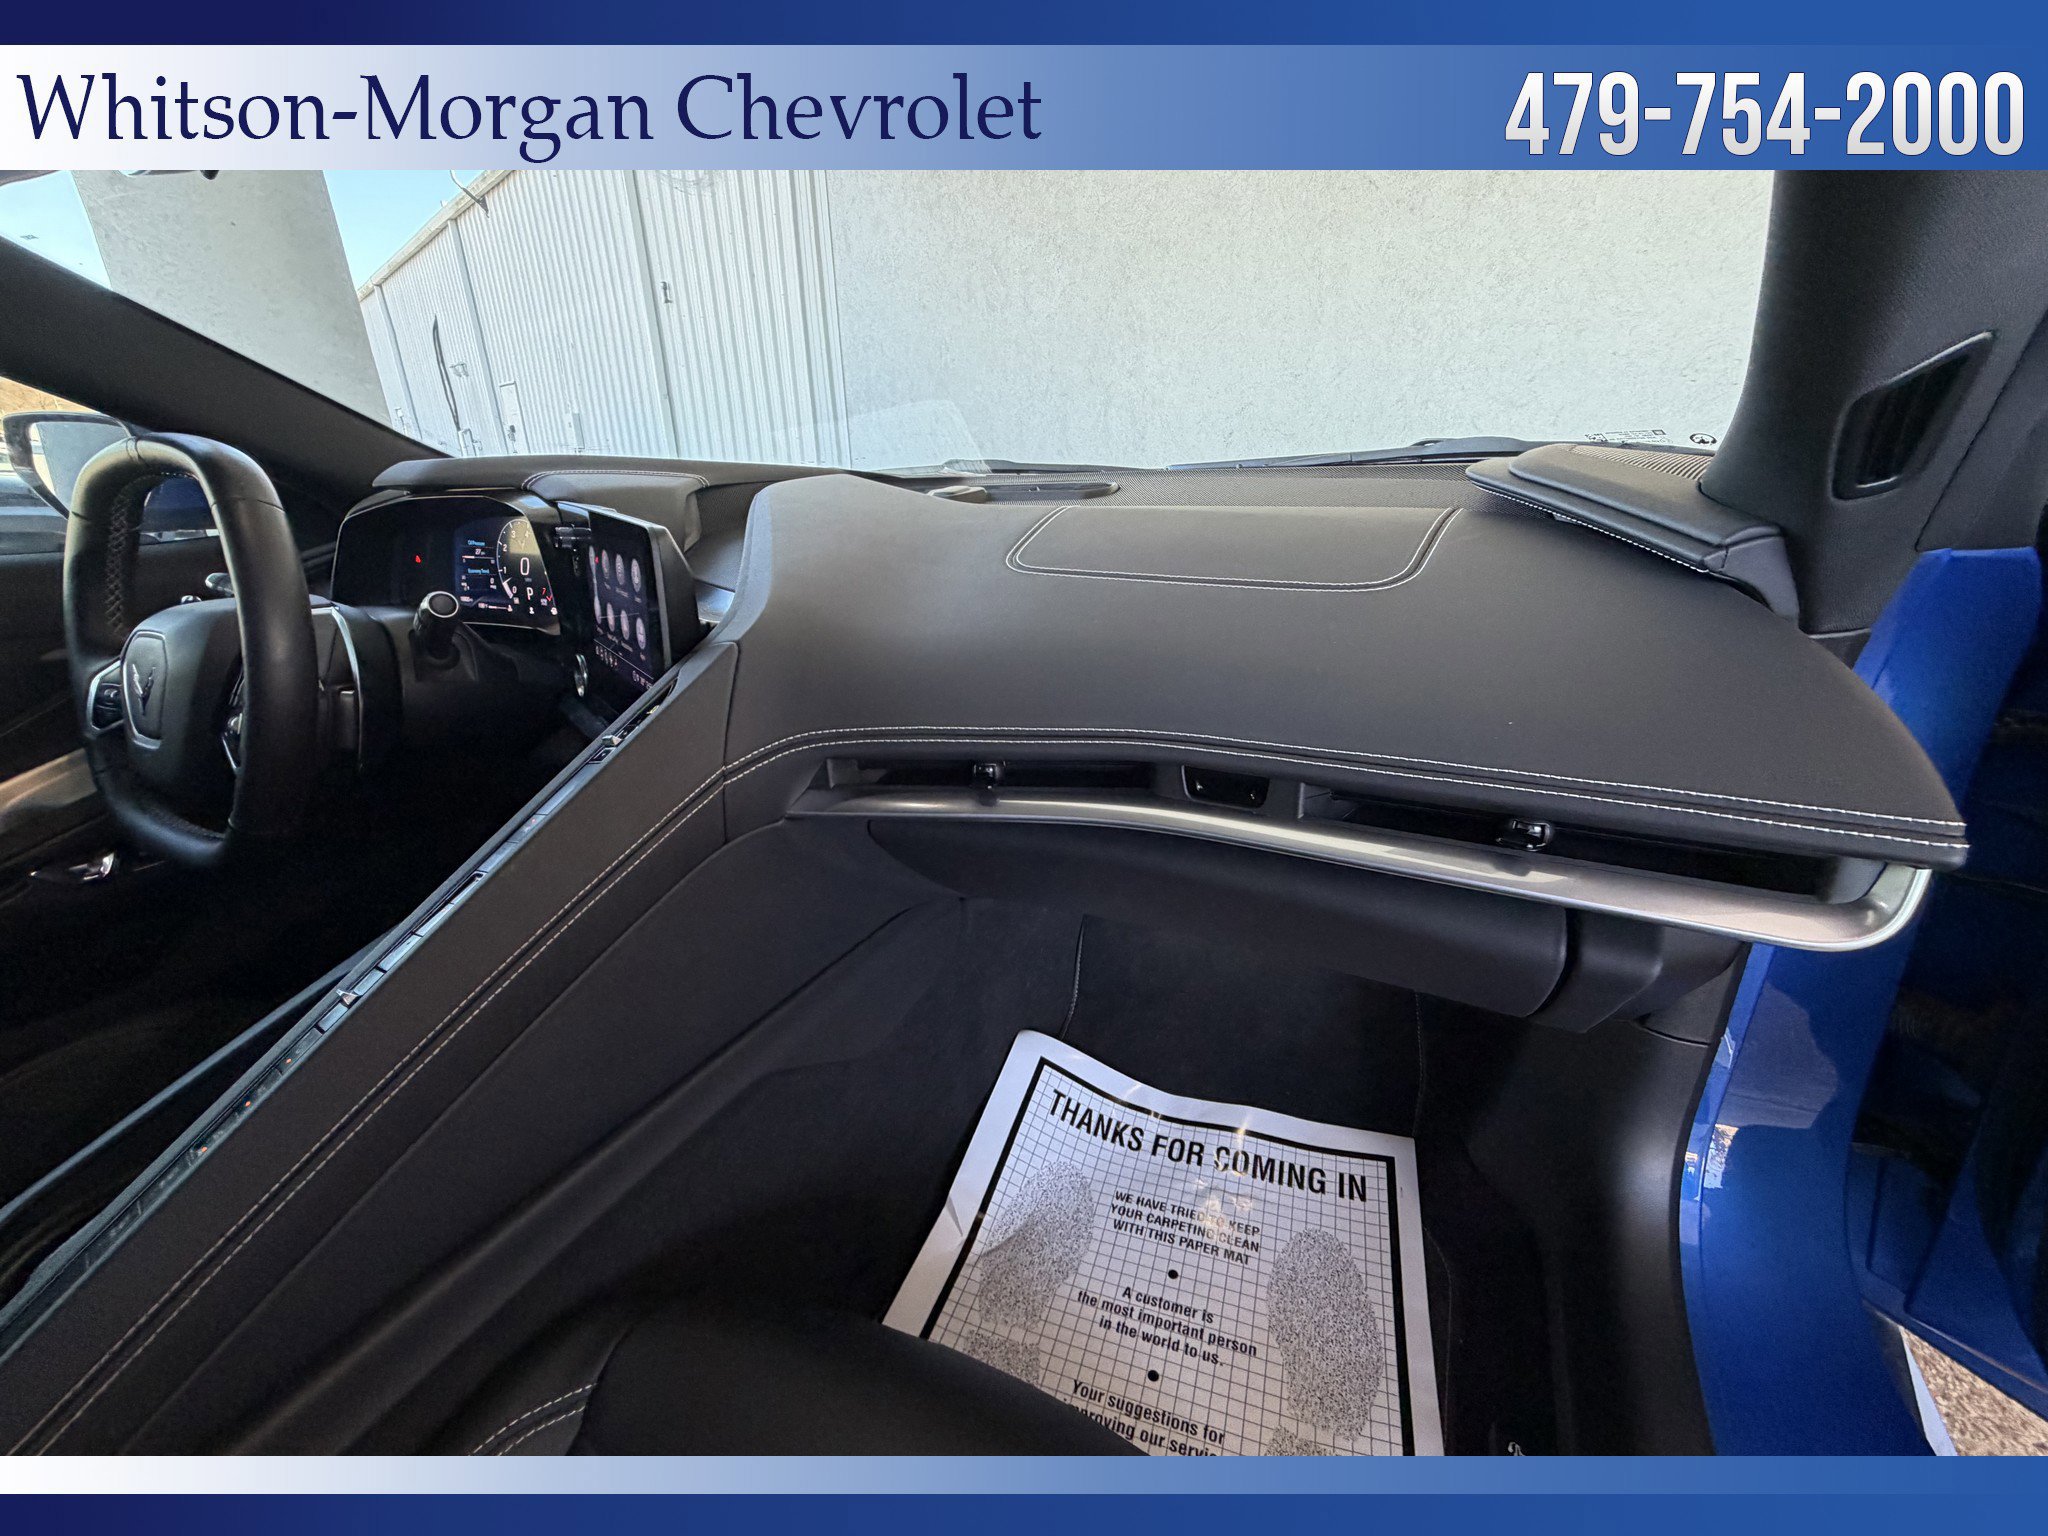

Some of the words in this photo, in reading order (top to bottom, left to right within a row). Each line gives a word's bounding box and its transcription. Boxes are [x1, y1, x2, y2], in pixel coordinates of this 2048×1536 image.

[520, 557, 530, 575] 0
[526, 587, 534, 600] P
[1050, 1089, 1145, 1151] THANKS
[1151, 1134, 1205, 1167] FOR
[1214, 1146, 1326, 1195] COMING
[1338, 1172, 1367, 1202] IN
[1111, 1203, 1143, 1221] YOUR
[1146, 1213, 1215, 1240] CARPETING
[1218, 1232, 1260, 1252] CLEAN
[1115, 1191, 1134, 1204] WE
[1136, 1195, 1167, 1212] HAVE
[1170, 1204, 1205, 1222] TRIED
[1209, 1214, 1225, 1228] TO
[1229, 1220, 1260, 1237] KEEP
[1113, 1219, 1144, 1236] WITH
[1149, 1228, 1175, 1244] THIS
[1179, 1236, 1219, 1257] PAPER
[1223, 1249, 1251, 1265] MAT
[1077, 1290, 1098, 1307] the
[1101, 1299, 1134, 1319] most
[1138, 1309, 1204, 1340] important
[1208, 1332, 1257, 1357] person
[1122, 1286, 1132, 1299] A
[1135, 1292, 1198, 1319] customer
[1202, 1310, 1214, 1324] is
[1099, 1315, 1112, 1330] in
[1116, 1321, 1137, 1338] the
[1141, 1331, 1180, 1352] world
[1184, 1342, 1198, 1358] to
[1202, 1351, 1224, 1367] us.
[1063, 1398, 1136, 1440] roving
[1139, 1429, 1166, 1448] our
[1073, 1379, 1105, 1403] Your
[1107, 1394, 1198, 1437] suggestions
[1203, 1424, 1226, 1445] for
